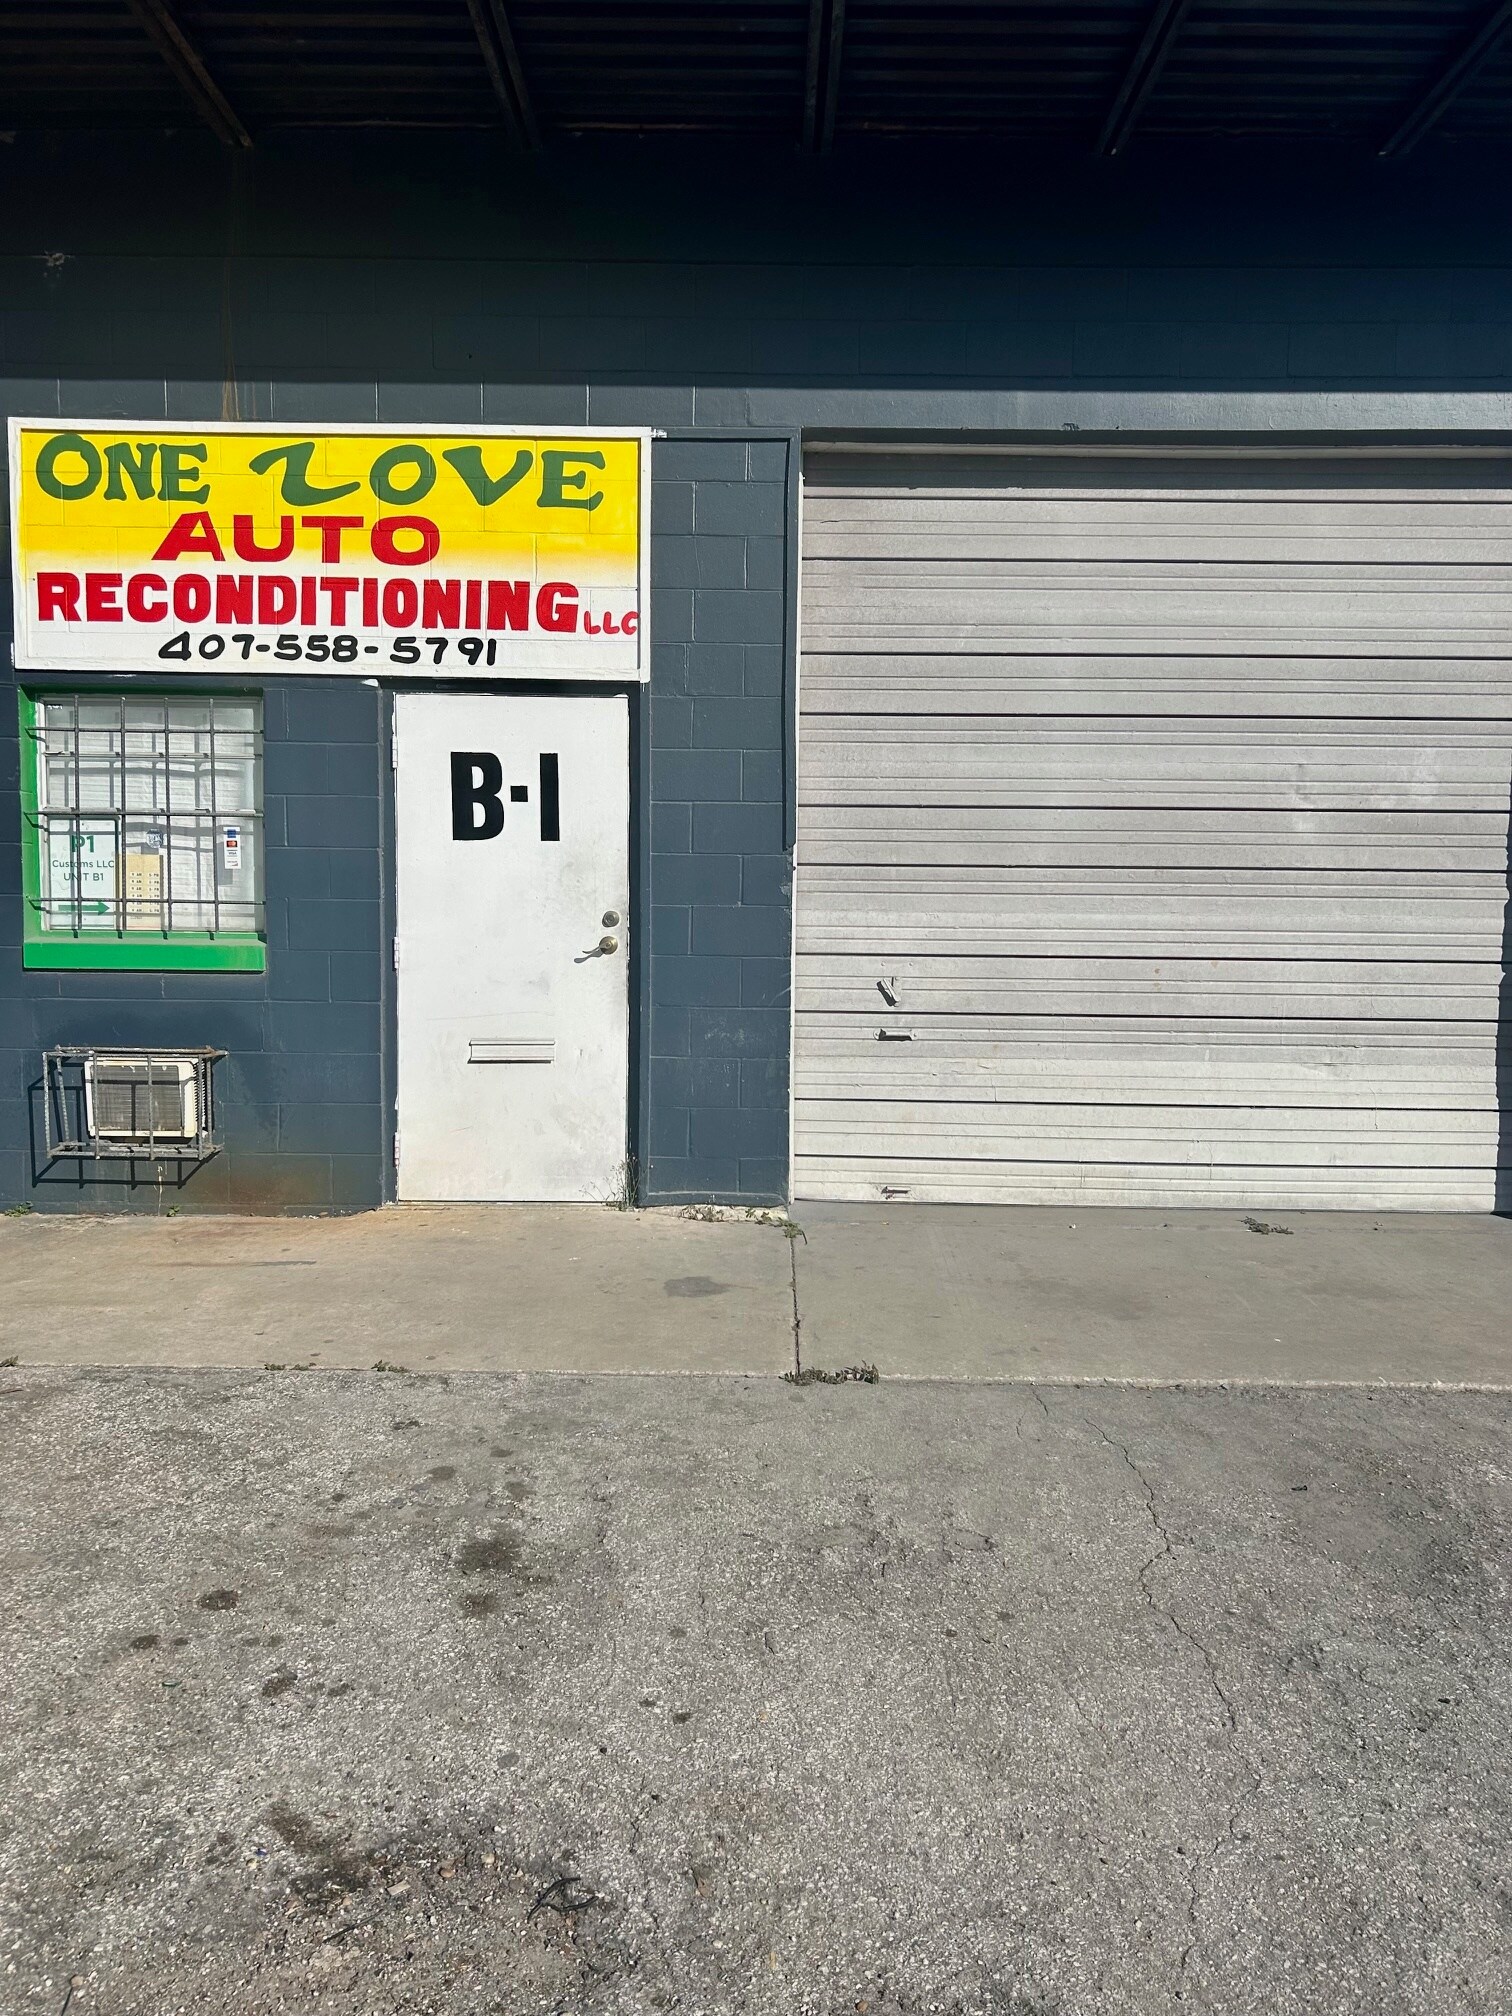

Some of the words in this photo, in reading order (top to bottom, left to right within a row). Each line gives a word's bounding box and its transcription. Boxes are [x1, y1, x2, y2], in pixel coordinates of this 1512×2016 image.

[35, 432, 211, 504] ONE
[248, 441, 606, 511] LOVE
[151, 510, 441, 567] AUTO
[36, 571, 580, 634] RECONDITIONING
[583, 610, 640, 636] LLC
[71, 835, 94, 853] P1
[63, 872, 89, 881] UNT
[92, 872, 104, 881] B1
[96, 860, 115, 868] LLC
